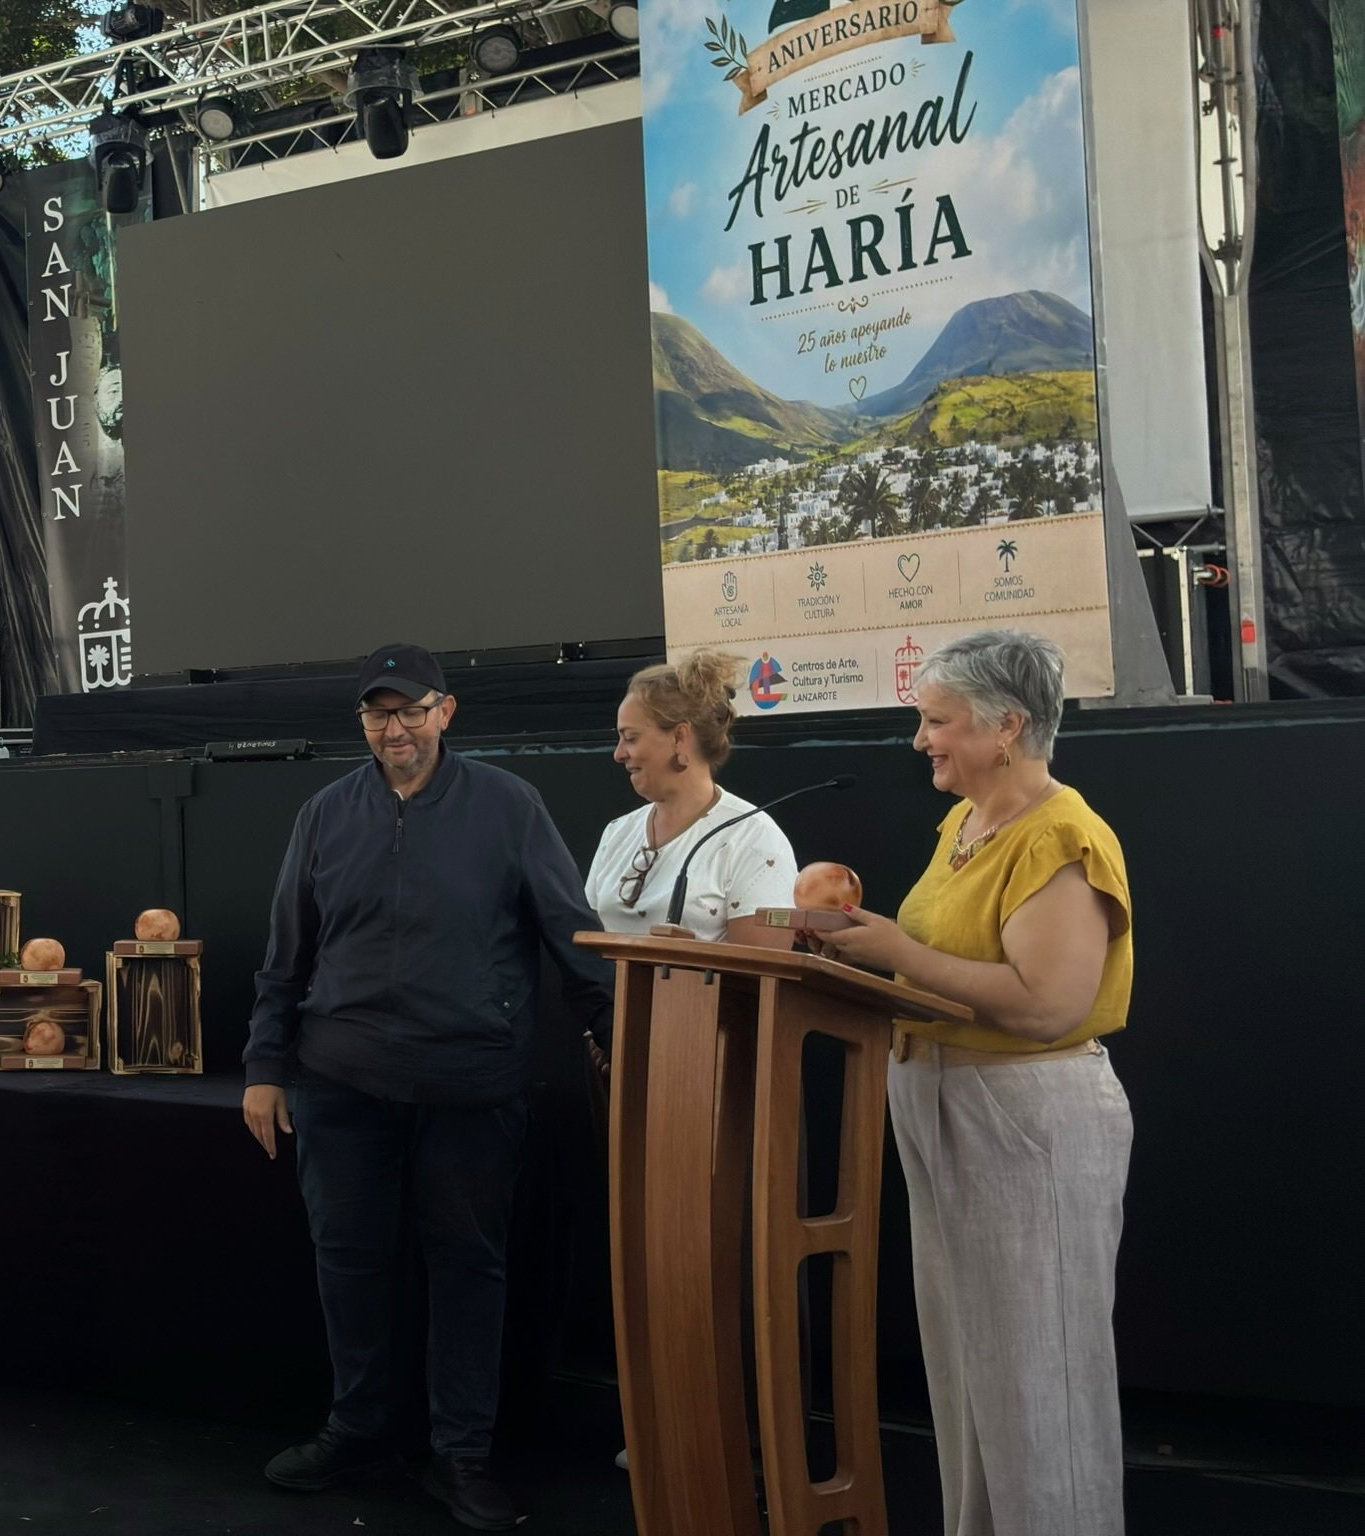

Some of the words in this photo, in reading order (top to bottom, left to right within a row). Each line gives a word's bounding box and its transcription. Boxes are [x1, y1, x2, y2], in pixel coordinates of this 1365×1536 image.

[766, 1, 919, 74] ANIVERSARIO
[787, 63, 906, 119] MERCADO
[723, 50, 978, 232] Artesanal
[835, 185, 860, 209] DE
[747, 188, 973, 306] HARÍA
[41, 196, 72, 322] SAN
[797, 330, 817, 354] 25
[819, 329, 846, 348] años
[850, 306, 912, 346] apoyando
[824, 352, 837, 373] lo
[840, 342, 887, 369] nuestro
[46, 351, 84, 521] JUAN
[993, 575, 1024, 588] SOMOS
[888, 586, 915, 599] HECHO
[916, 584, 934, 596] CON
[984, 587, 1035, 602] COMUNIDAD
[798, 595, 834, 608] TRADICIÓN
[835, 594, 841, 604] Y
[899, 599, 923, 611] AMOR
[714, 604, 749, 616] ARTESANÍA
[803, 609, 835, 620] CULTURA
[721, 618, 743, 628] LOCAL
[791, 660, 825, 672] Centros
[826, 659, 836, 670] de
[838, 658, 859, 669] Arte,
[792, 676, 823, 687] Cultura
[824, 677, 829, 687] y
[829, 673, 864, 685] Turismo
[792, 691, 838, 703] LANZAROTE
